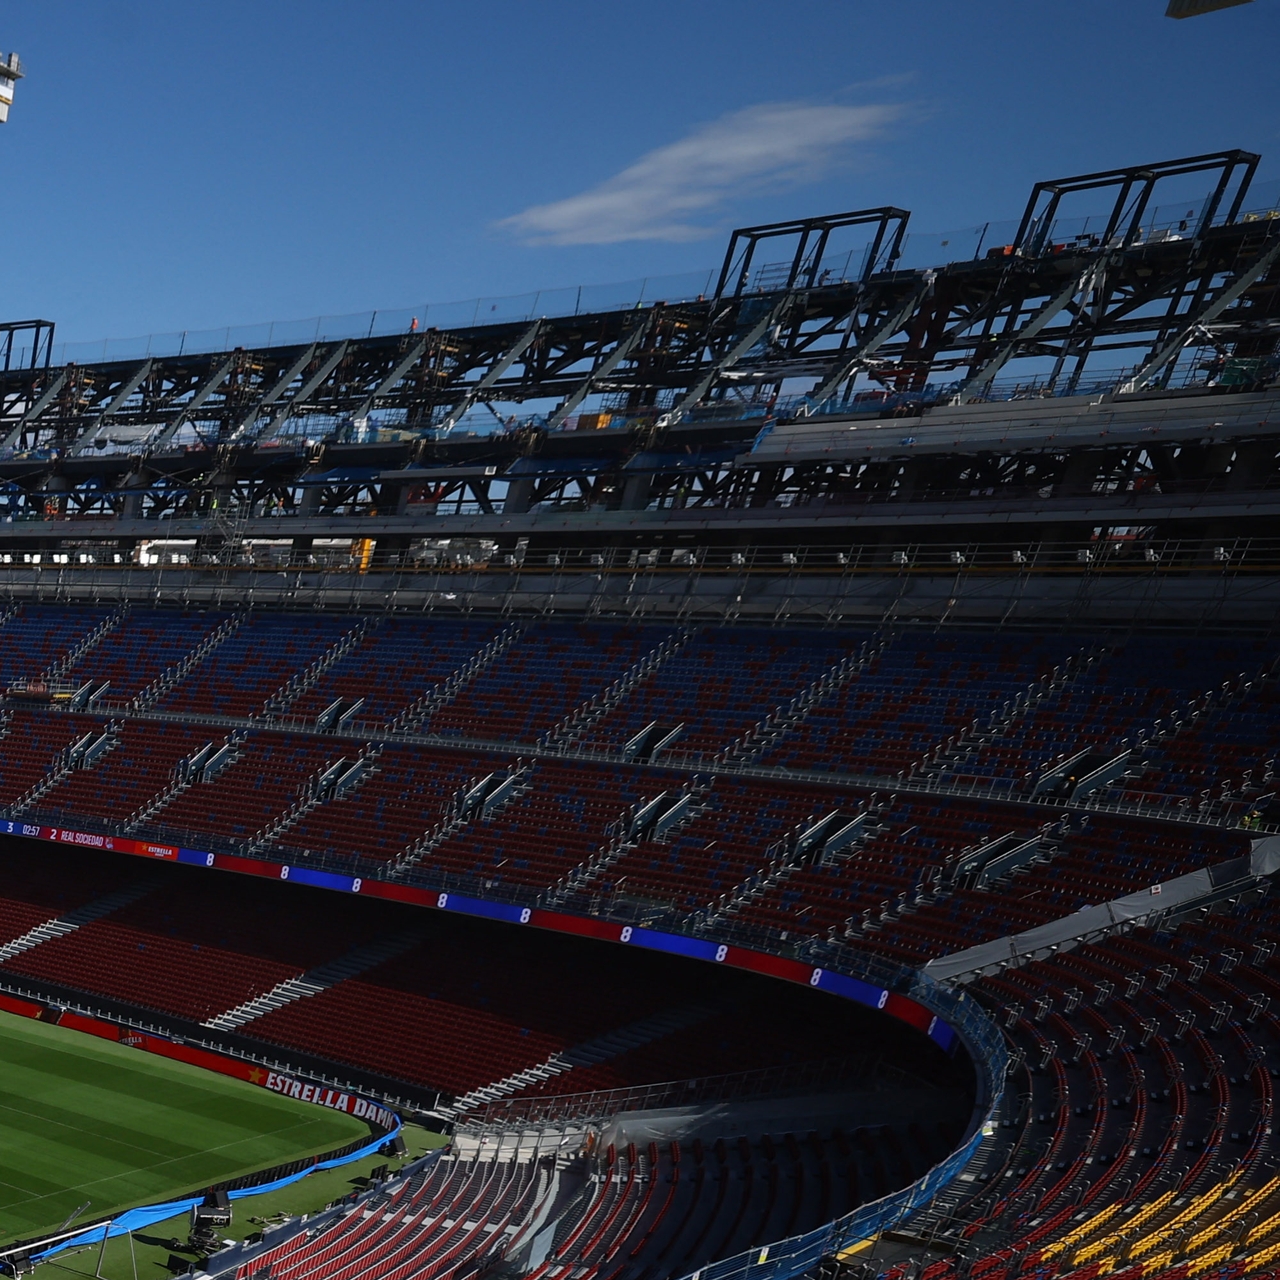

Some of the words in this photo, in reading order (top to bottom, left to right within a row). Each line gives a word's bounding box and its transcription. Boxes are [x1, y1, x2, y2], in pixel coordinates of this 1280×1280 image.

[7, 822, 14, 833] 3
[22, 824, 41, 837] 02:57
[49, 829, 57, 839] 2
[60, 830, 75, 842] REAL
[75, 832, 104, 847] SOCIEDAD
[148, 846, 172, 855] ESTRELLA
[206, 853, 214, 866] 8
[280, 865, 289, 879] 8
[351, 878, 362, 893] 8
[437, 893, 448, 908] 8
[520, 908, 531, 924] 8
[620, 926, 632, 942] 8
[715, 944, 728, 962] 8
[810, 968, 822, 986] 8
[877, 990, 889, 1009] 8
[927, 1016, 938, 1035] 8
[265, 1072, 348, 1113] ESTRELLA
